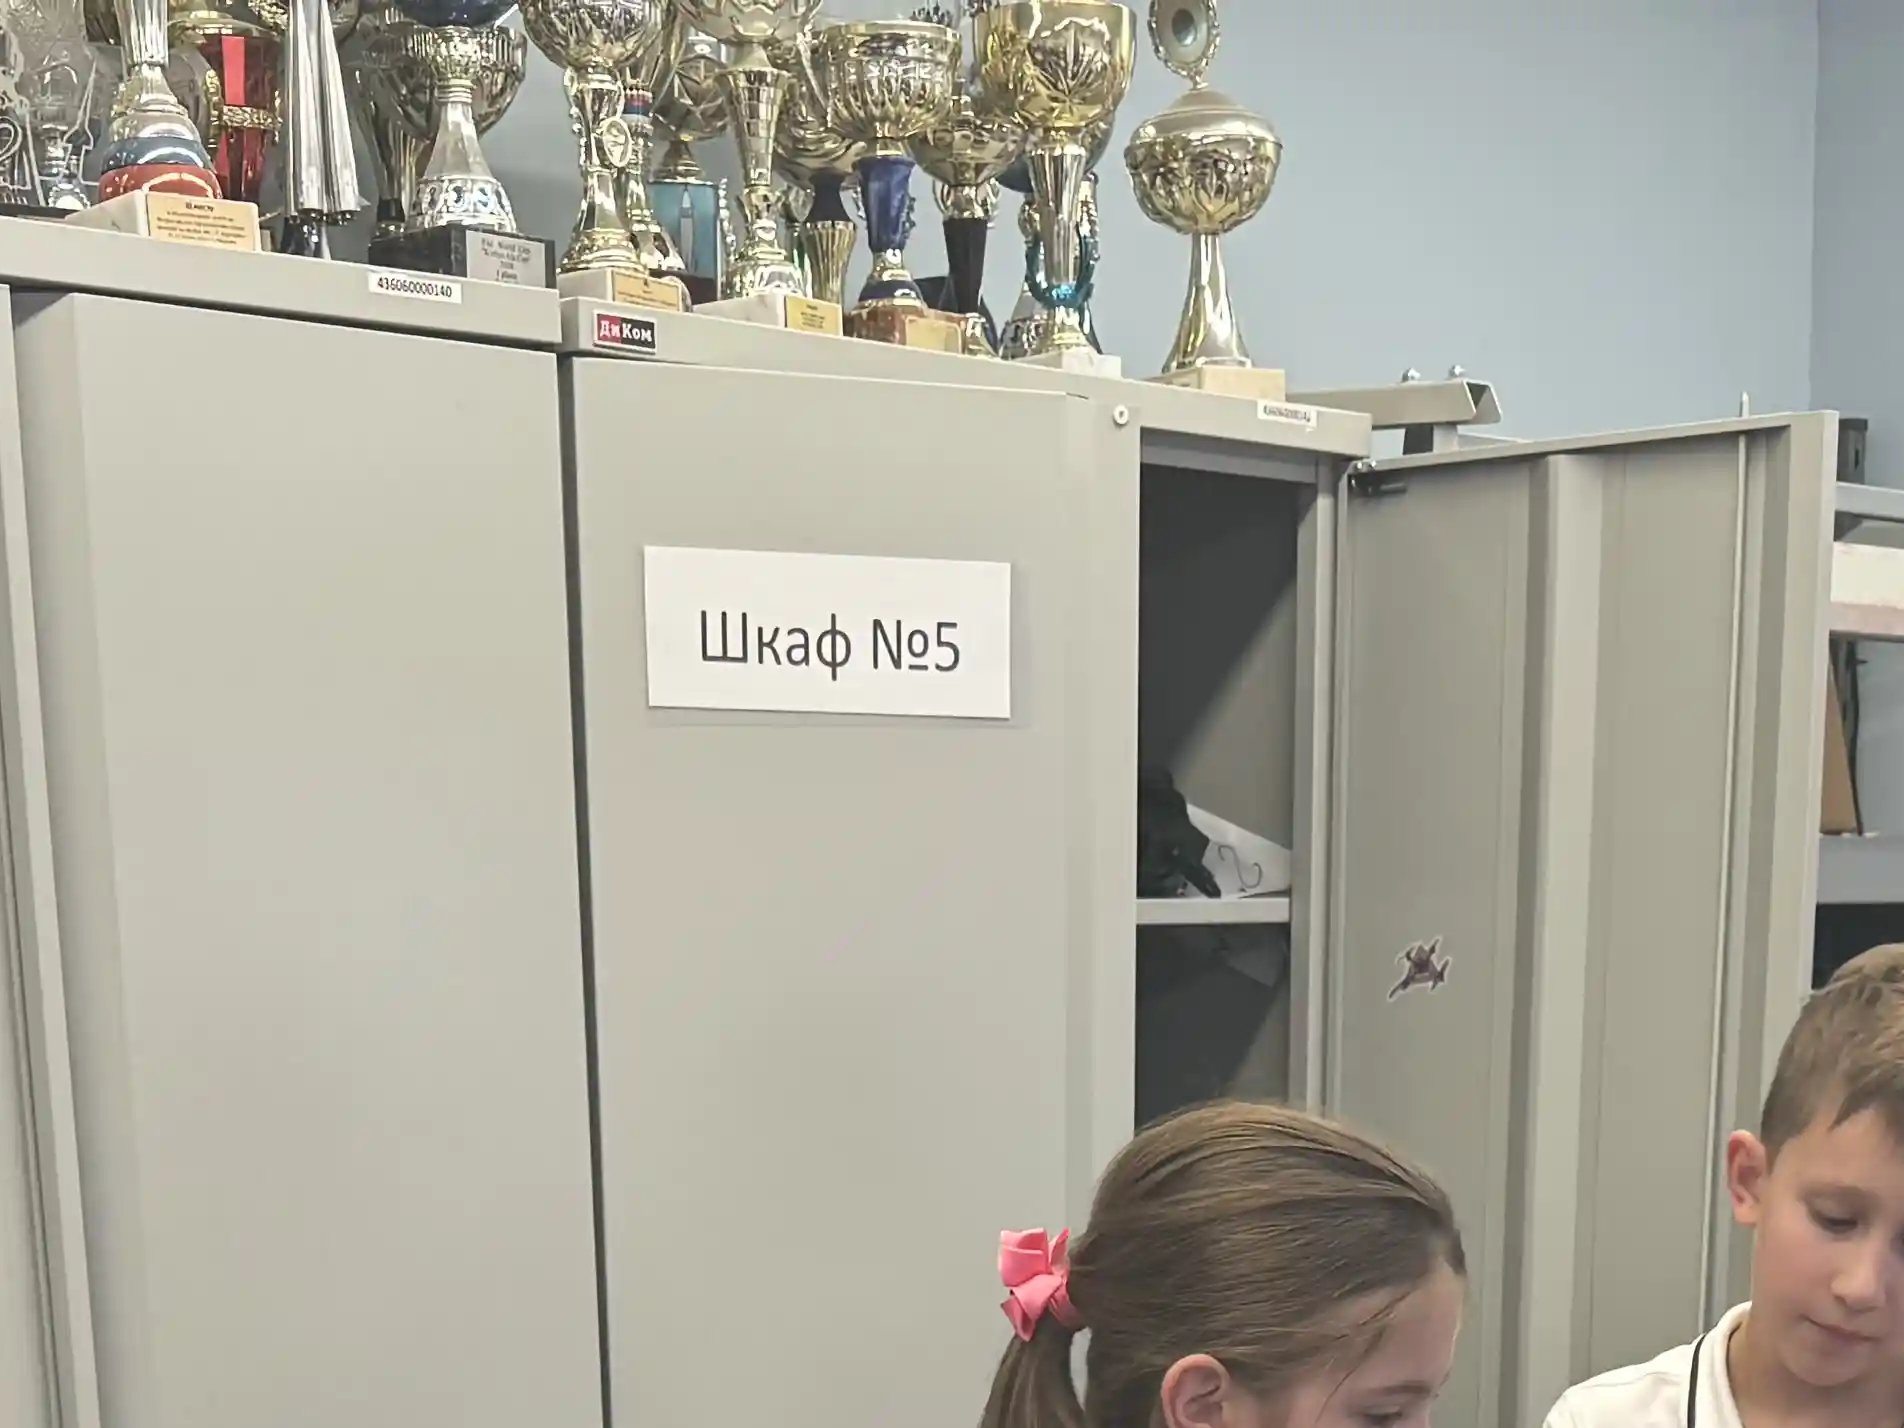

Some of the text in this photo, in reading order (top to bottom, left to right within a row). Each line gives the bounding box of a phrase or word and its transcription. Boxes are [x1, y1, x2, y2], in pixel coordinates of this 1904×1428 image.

[377, 276, 452, 298] 436060000140
[599, 320, 652, 342] ДиКом
[701, 610, 961, 682] Шкаф №5
